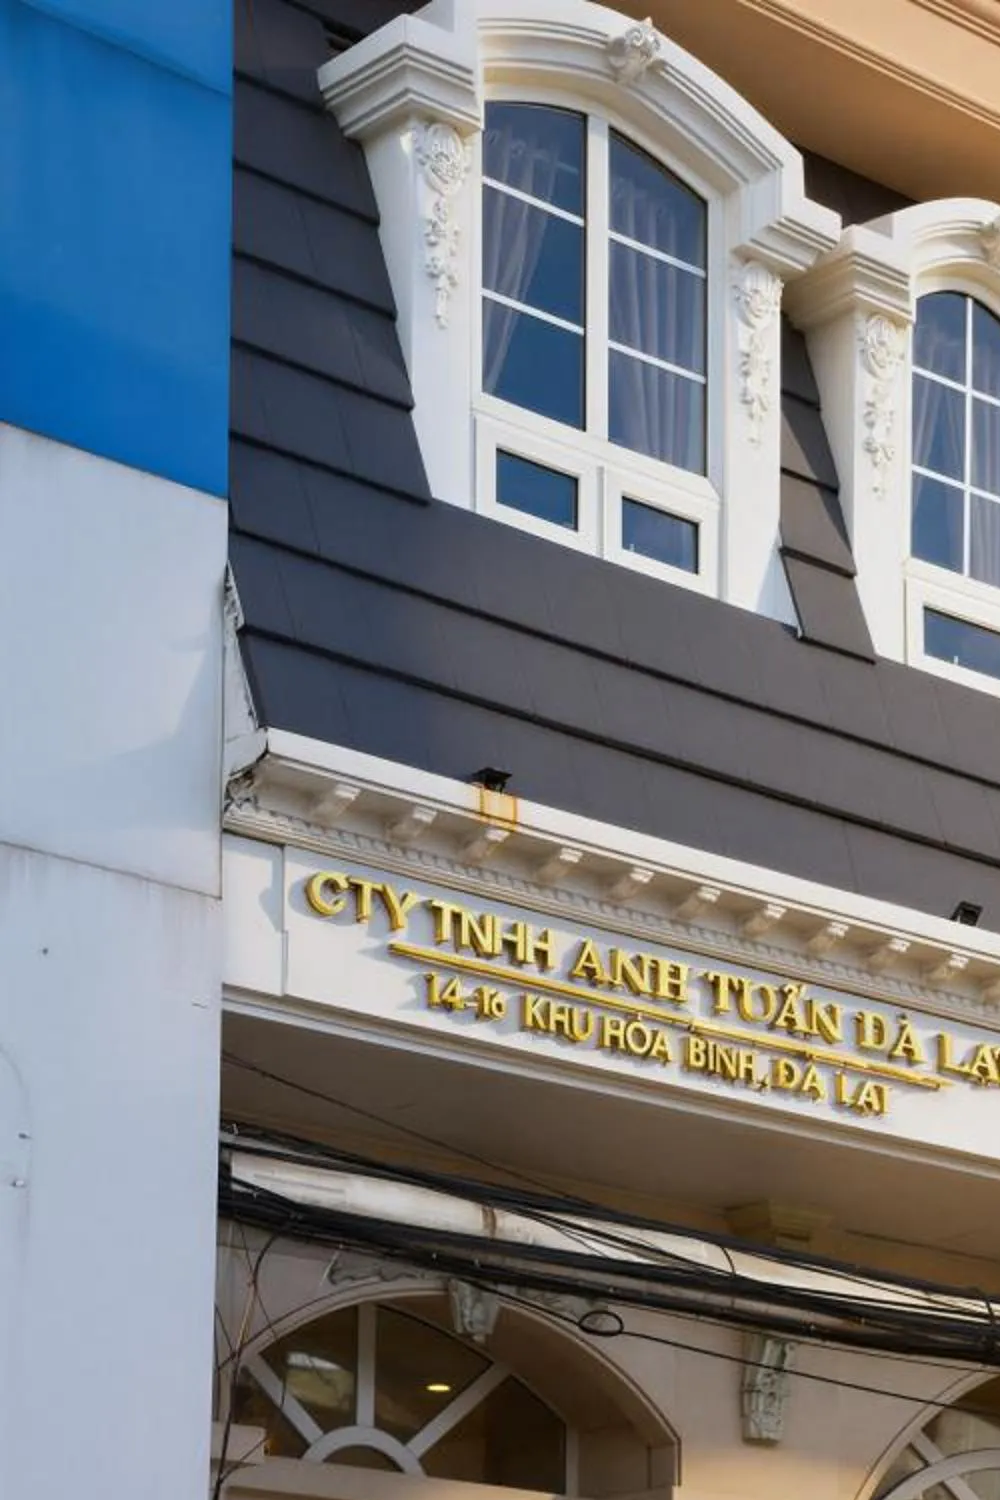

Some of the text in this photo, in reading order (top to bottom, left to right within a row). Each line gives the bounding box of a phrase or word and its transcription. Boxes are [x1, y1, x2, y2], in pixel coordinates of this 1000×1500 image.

[306, 871, 415, 930] CTY
[429, 898, 555, 969] TNHH
[571, 937, 690, 1003] ANH
[522, 993, 594, 1042] KHU
